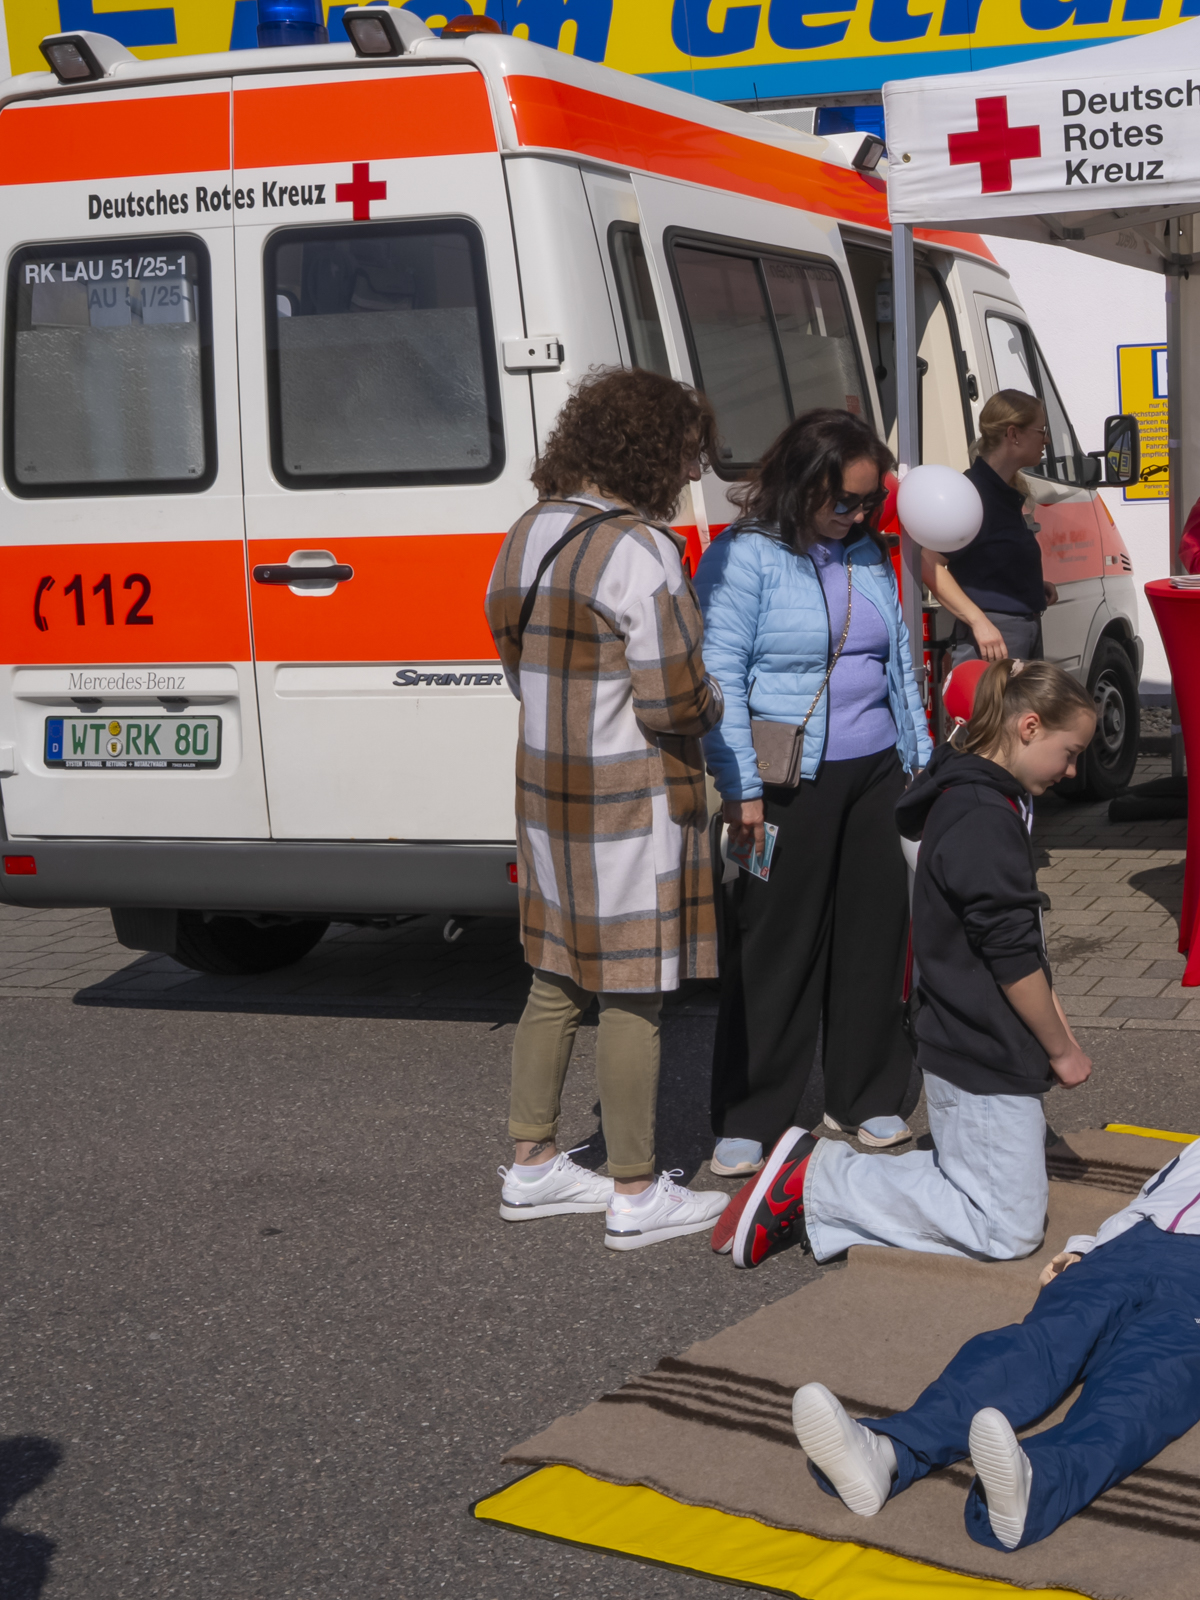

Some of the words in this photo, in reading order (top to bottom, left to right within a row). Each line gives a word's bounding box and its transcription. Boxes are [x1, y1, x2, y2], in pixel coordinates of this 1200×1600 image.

[1063, 121, 1164, 152] Rotes
[1065, 158, 1164, 185] Kreuz
[88, 189, 189, 220] Deutsches
[195, 184, 255, 212] Rotes
[262, 181, 326, 208] Kreuz
[25, 263, 56, 285] RK
[61, 260, 104, 283] LAU
[110, 255, 187, 279] 51/25-1
[63, 572, 154, 626] 112
[68, 672, 186, 690] Mercedes-Benz
[392, 669, 504, 687] SPRINTER
[71, 723, 106, 755] WT
[125, 723, 162, 755] RK
[174, 723, 209, 756] 80
